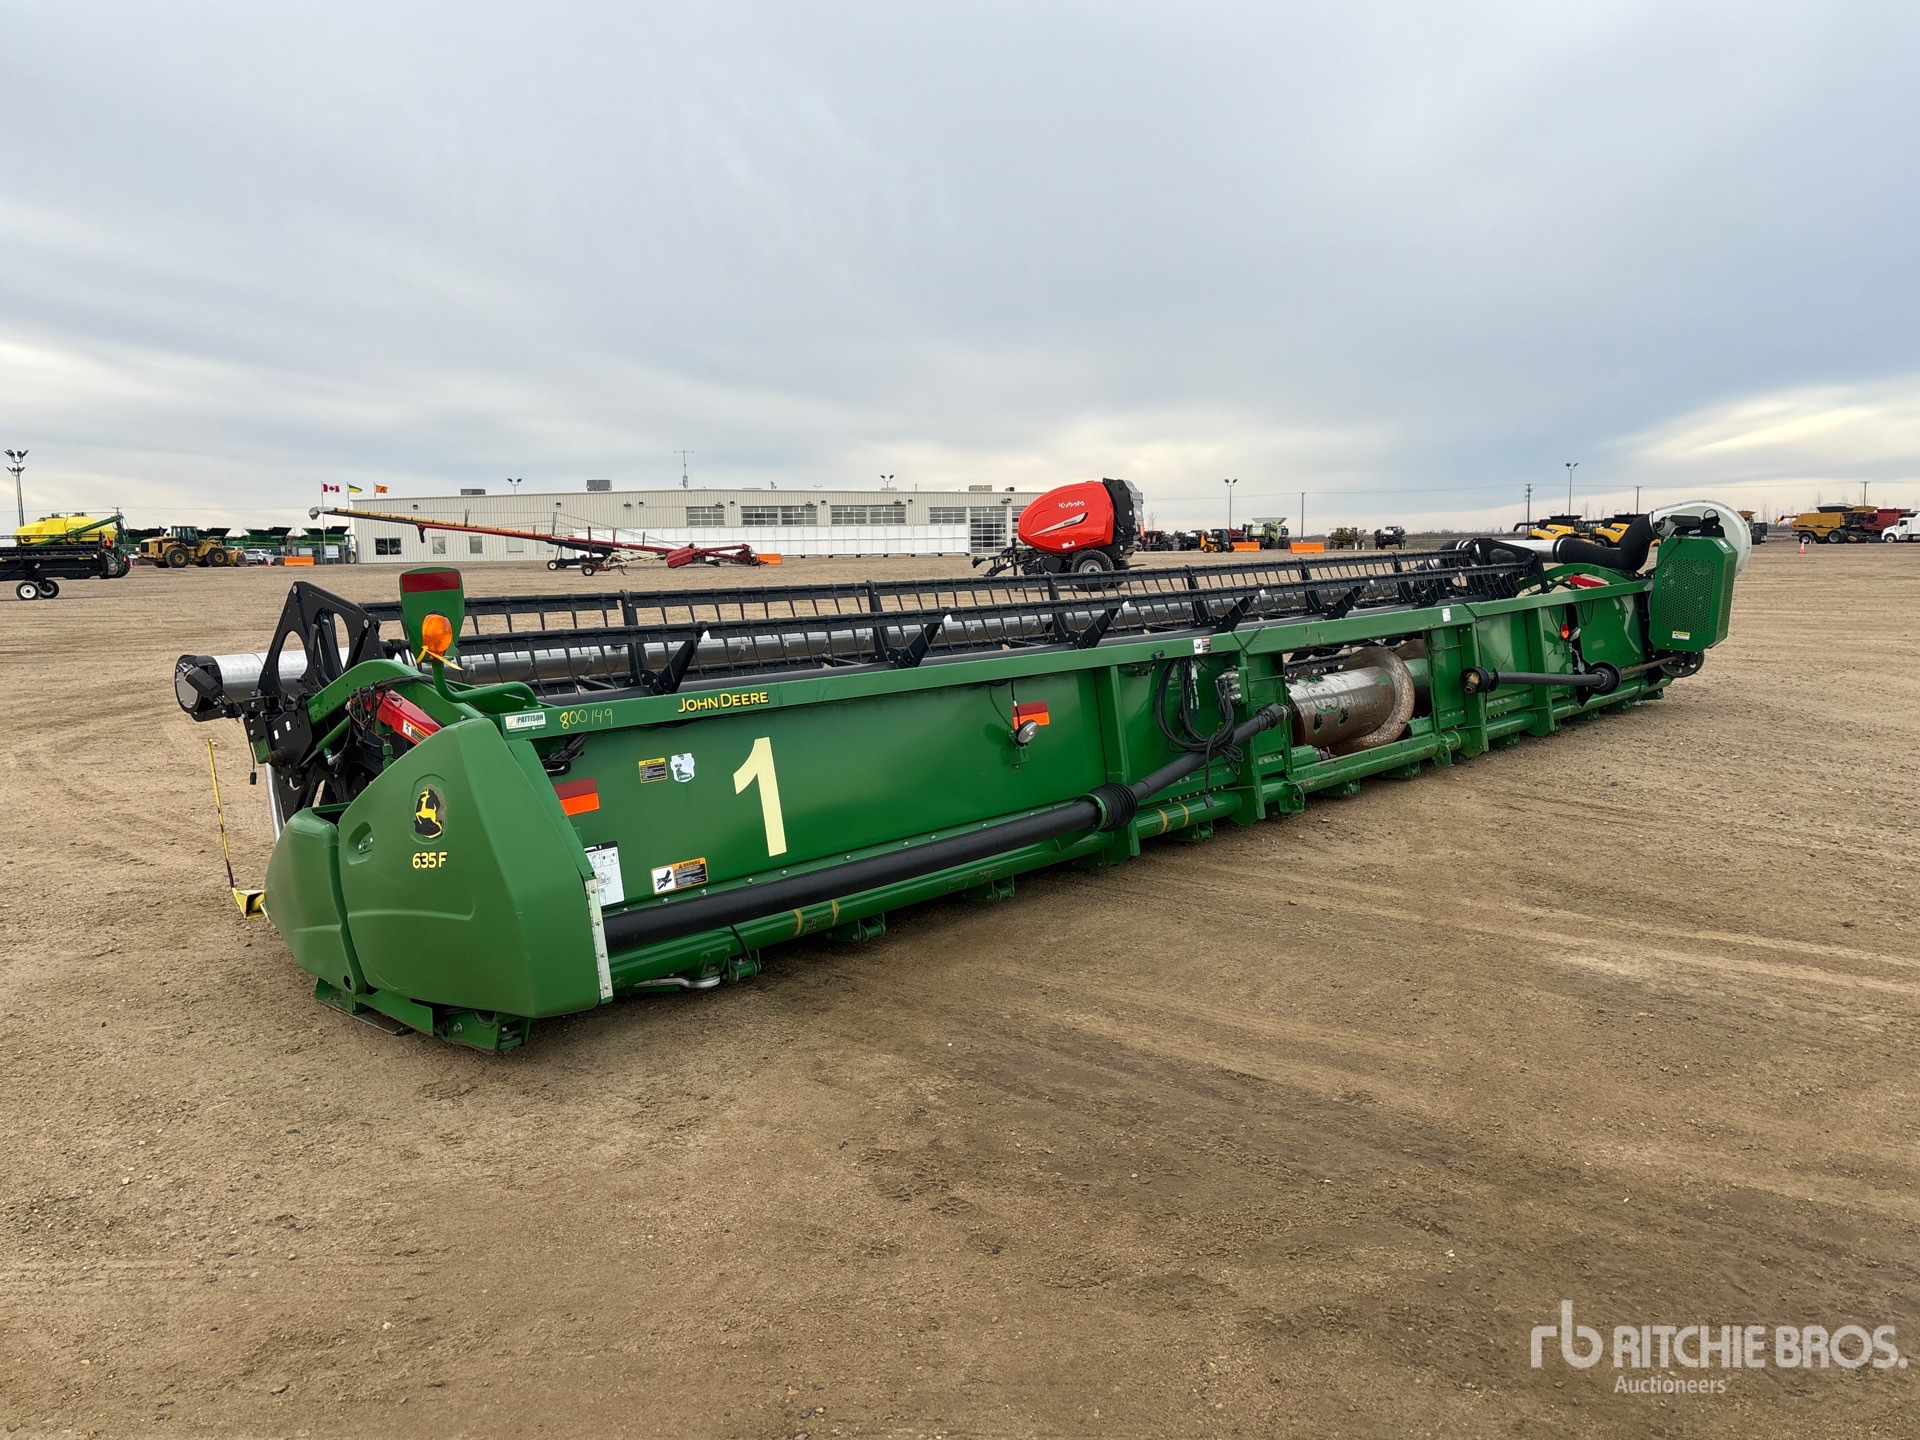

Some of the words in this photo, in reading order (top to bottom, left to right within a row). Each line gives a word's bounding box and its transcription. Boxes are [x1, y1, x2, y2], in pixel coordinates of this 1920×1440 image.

[1058, 500, 1085, 508] Kubota
[678, 697, 719, 713] JOHN
[720, 692, 769, 708] DEERE
[517, 713, 544, 724] PATTISON
[733, 736, 787, 857] 1
